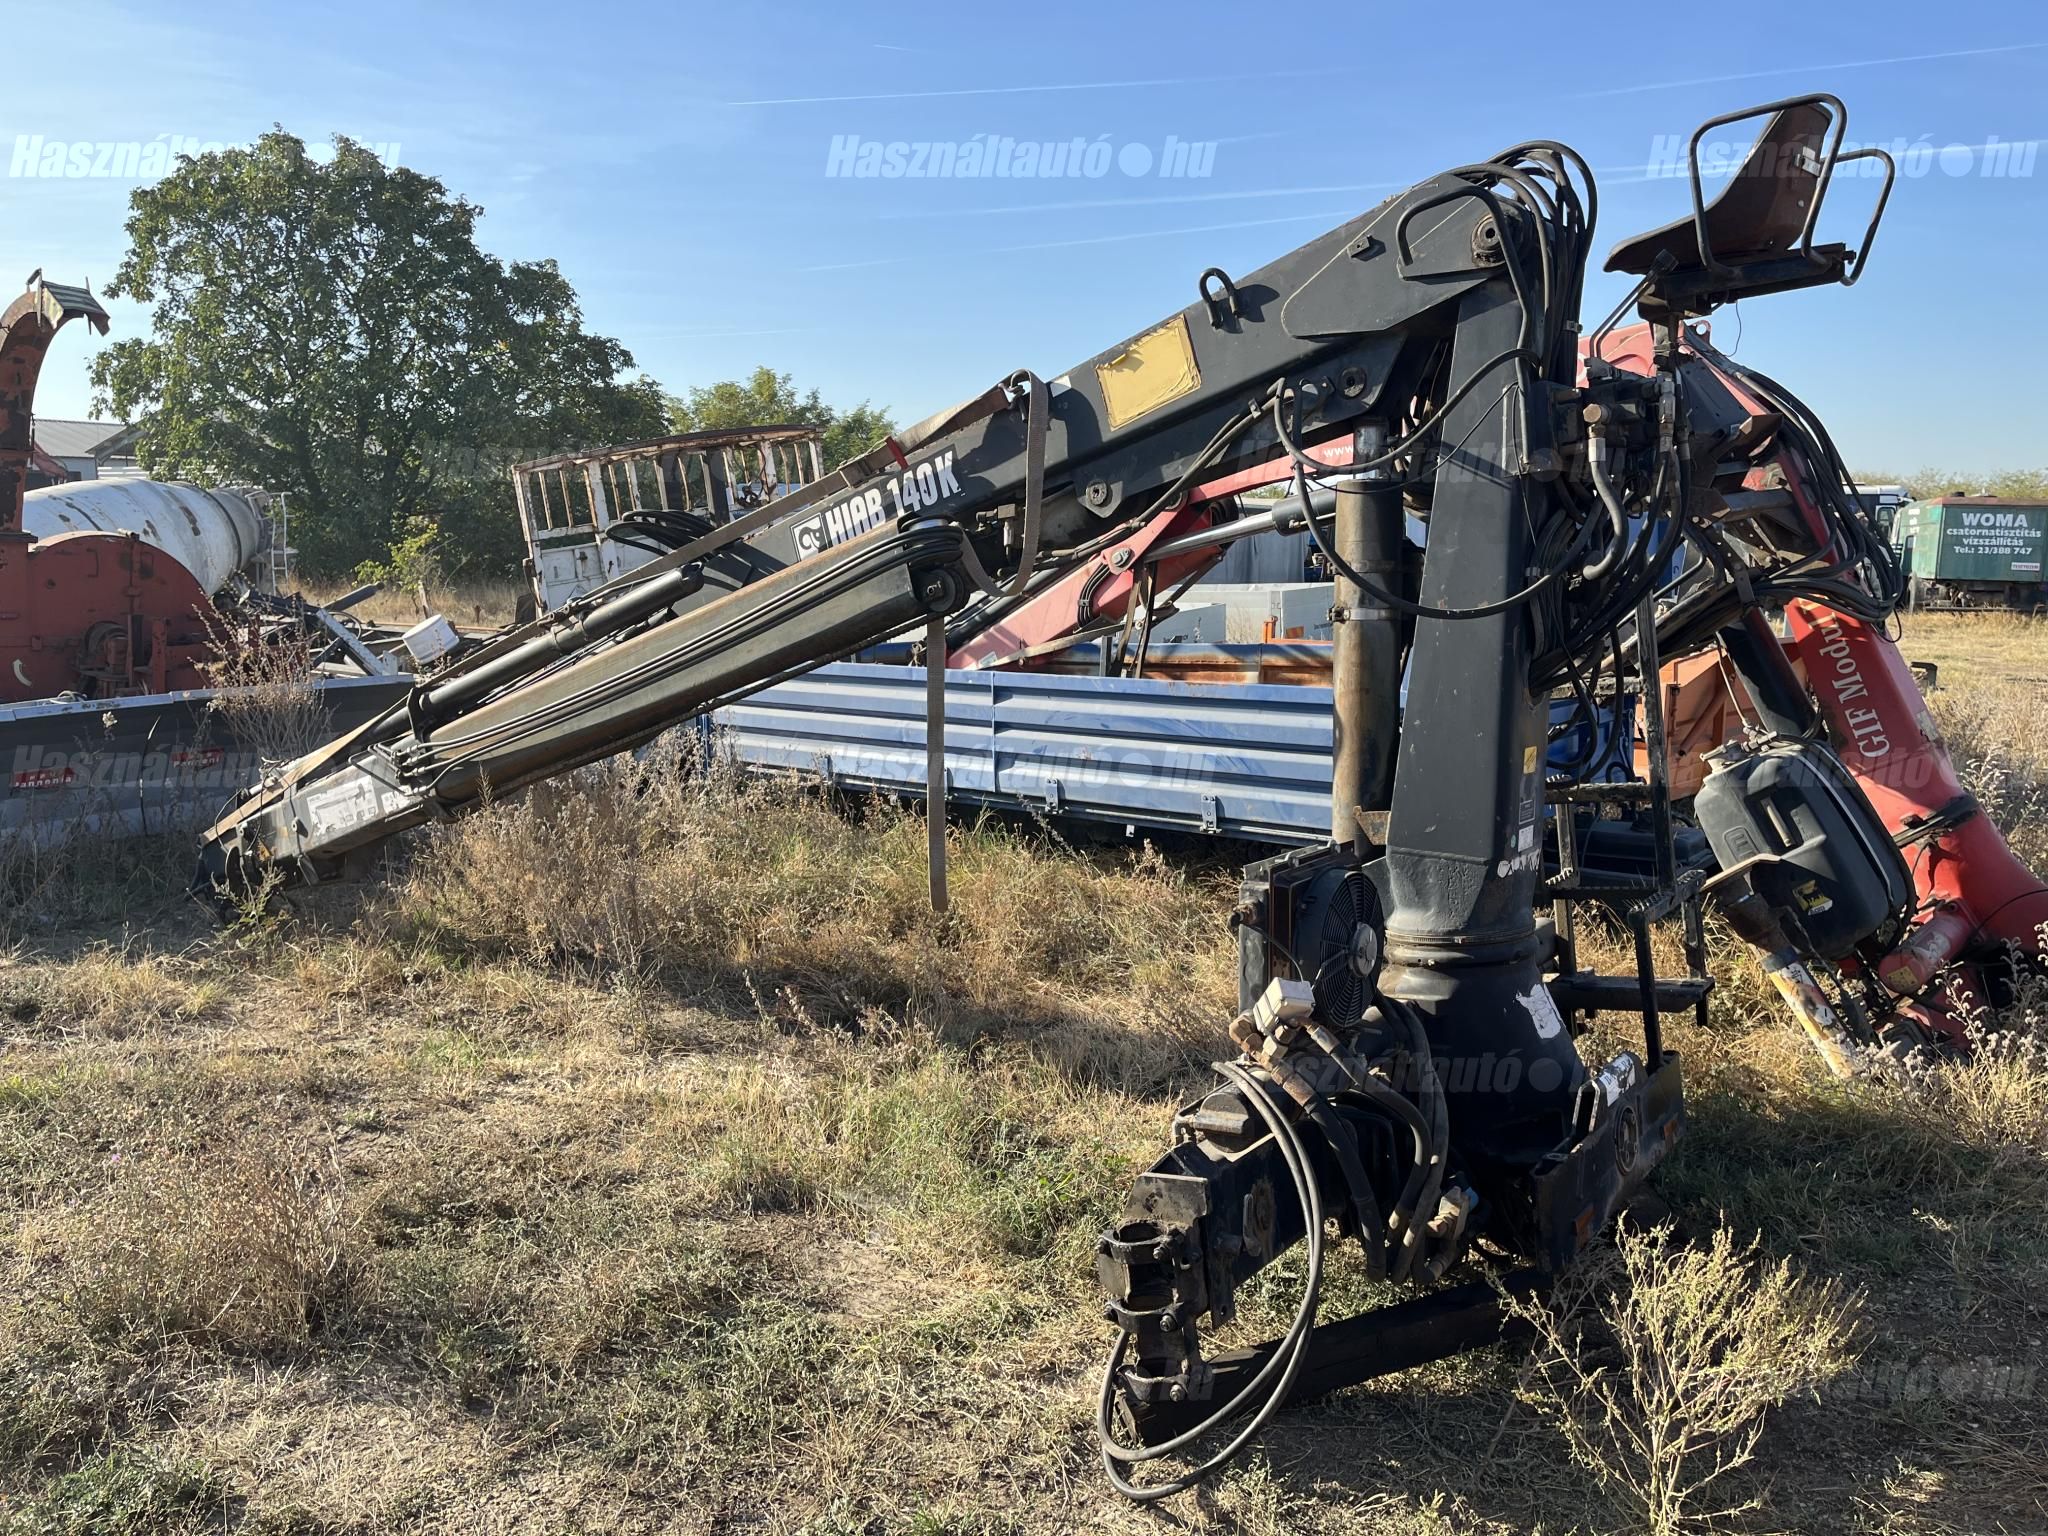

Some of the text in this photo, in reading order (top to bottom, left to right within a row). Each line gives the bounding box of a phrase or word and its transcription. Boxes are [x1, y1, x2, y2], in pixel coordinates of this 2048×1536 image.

[824, 488, 886, 545] HIAB
[1962, 512, 2028, 528] WOMA
[2013, 547, 2033, 555] 747
[1845, 707, 1890, 758] GIF
